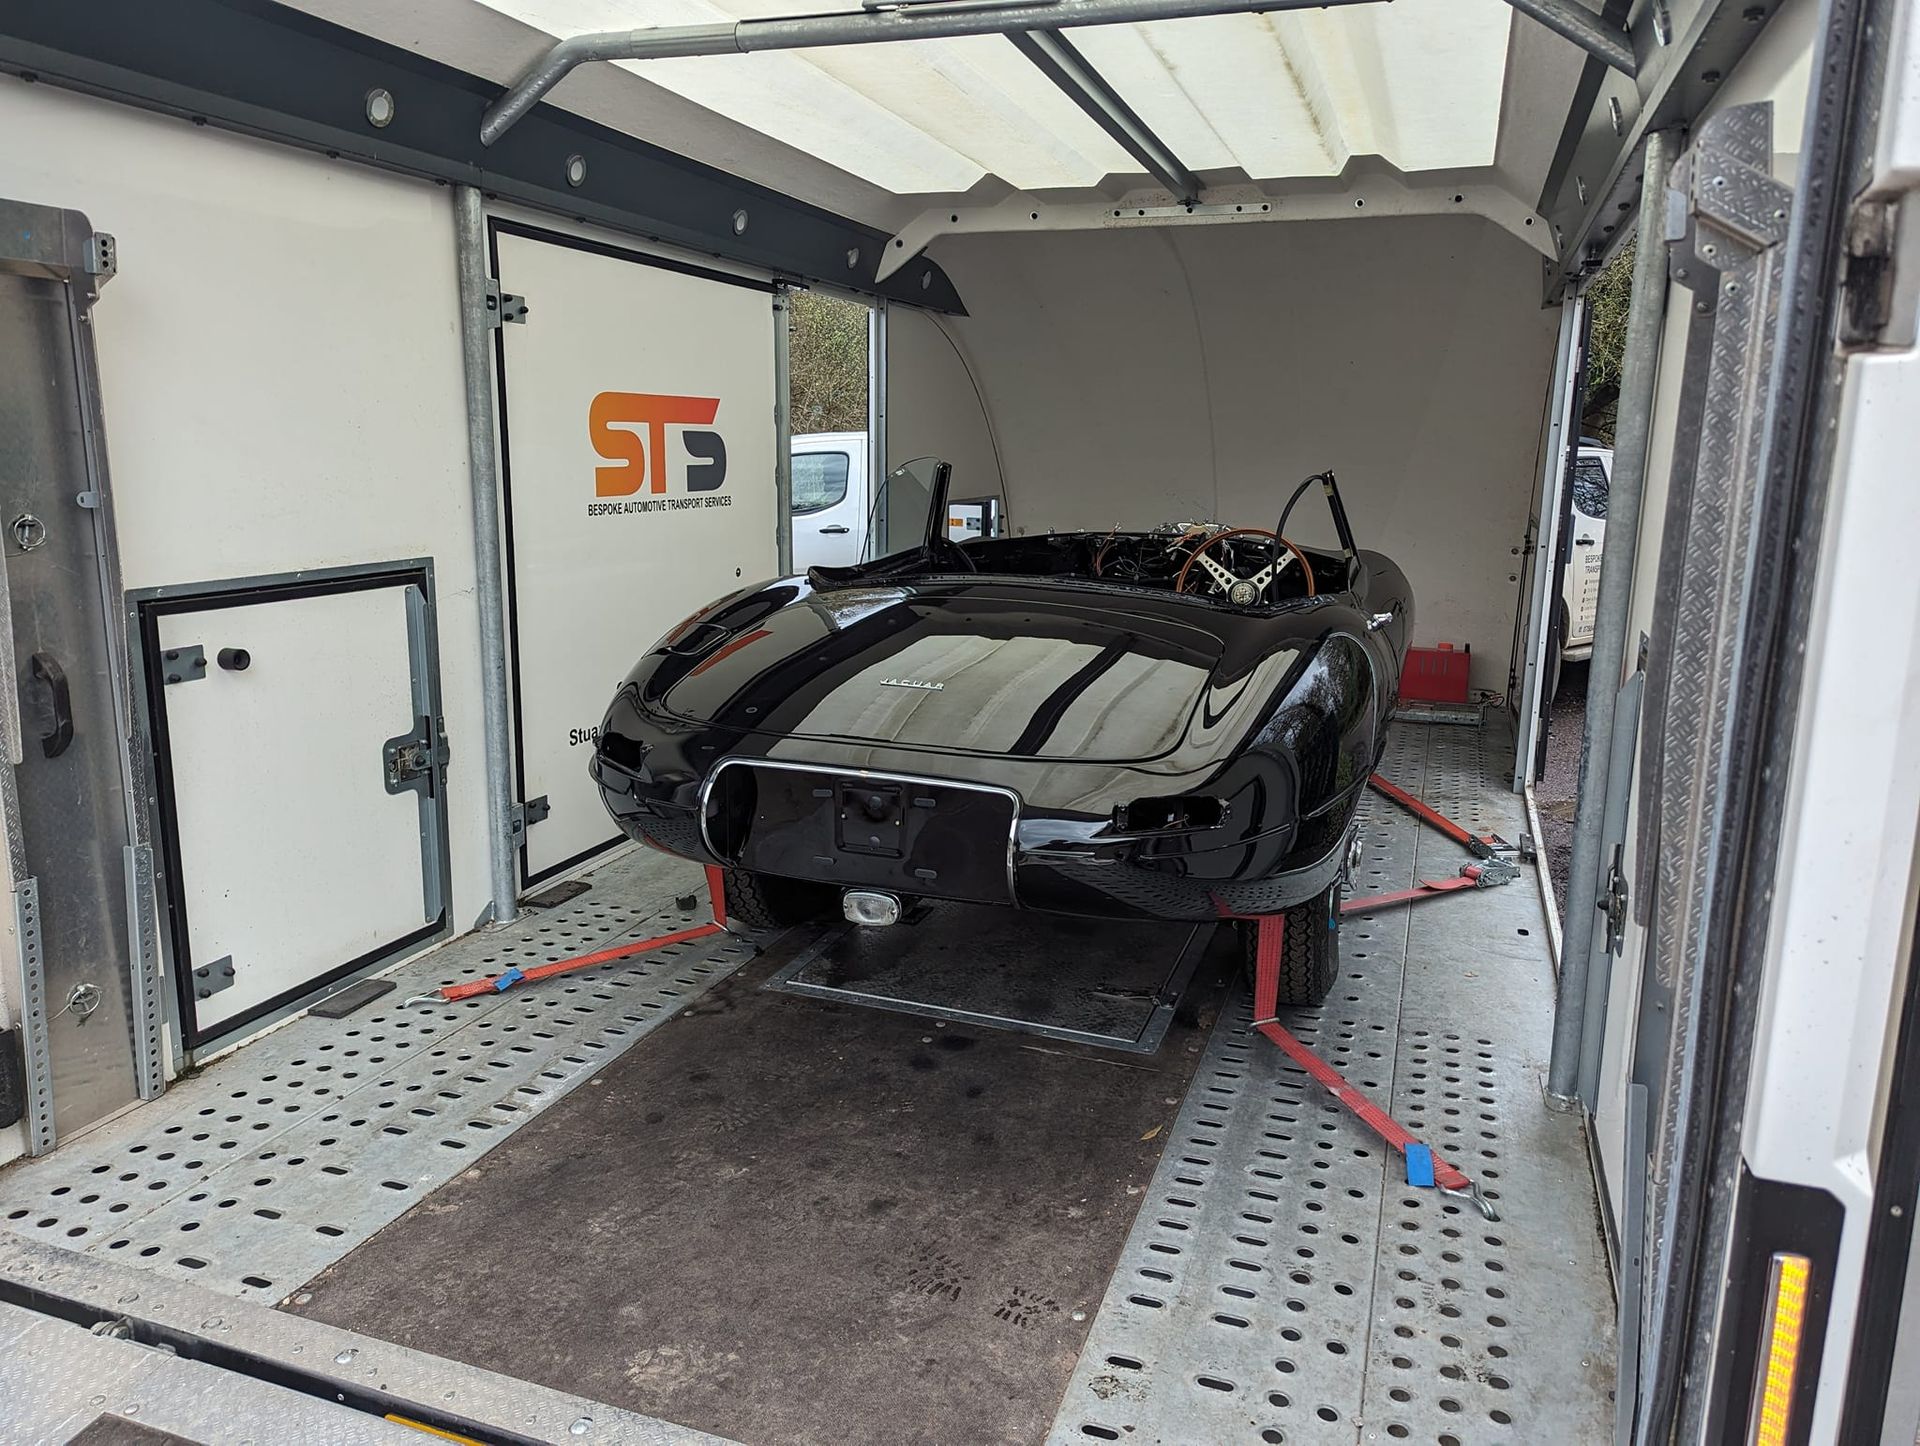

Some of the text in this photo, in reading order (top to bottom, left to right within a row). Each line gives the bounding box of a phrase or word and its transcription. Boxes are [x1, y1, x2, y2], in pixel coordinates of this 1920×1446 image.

[589, 391, 727, 498] STS
[588, 495, 732, 517] BESPOKE AUTOMOTIVE TRANSPORT SERVICES
[1585, 565, 1600, 574] TRANSP
[879, 677, 945, 692] JAGUAR
[569, 725, 600, 746] Stua
